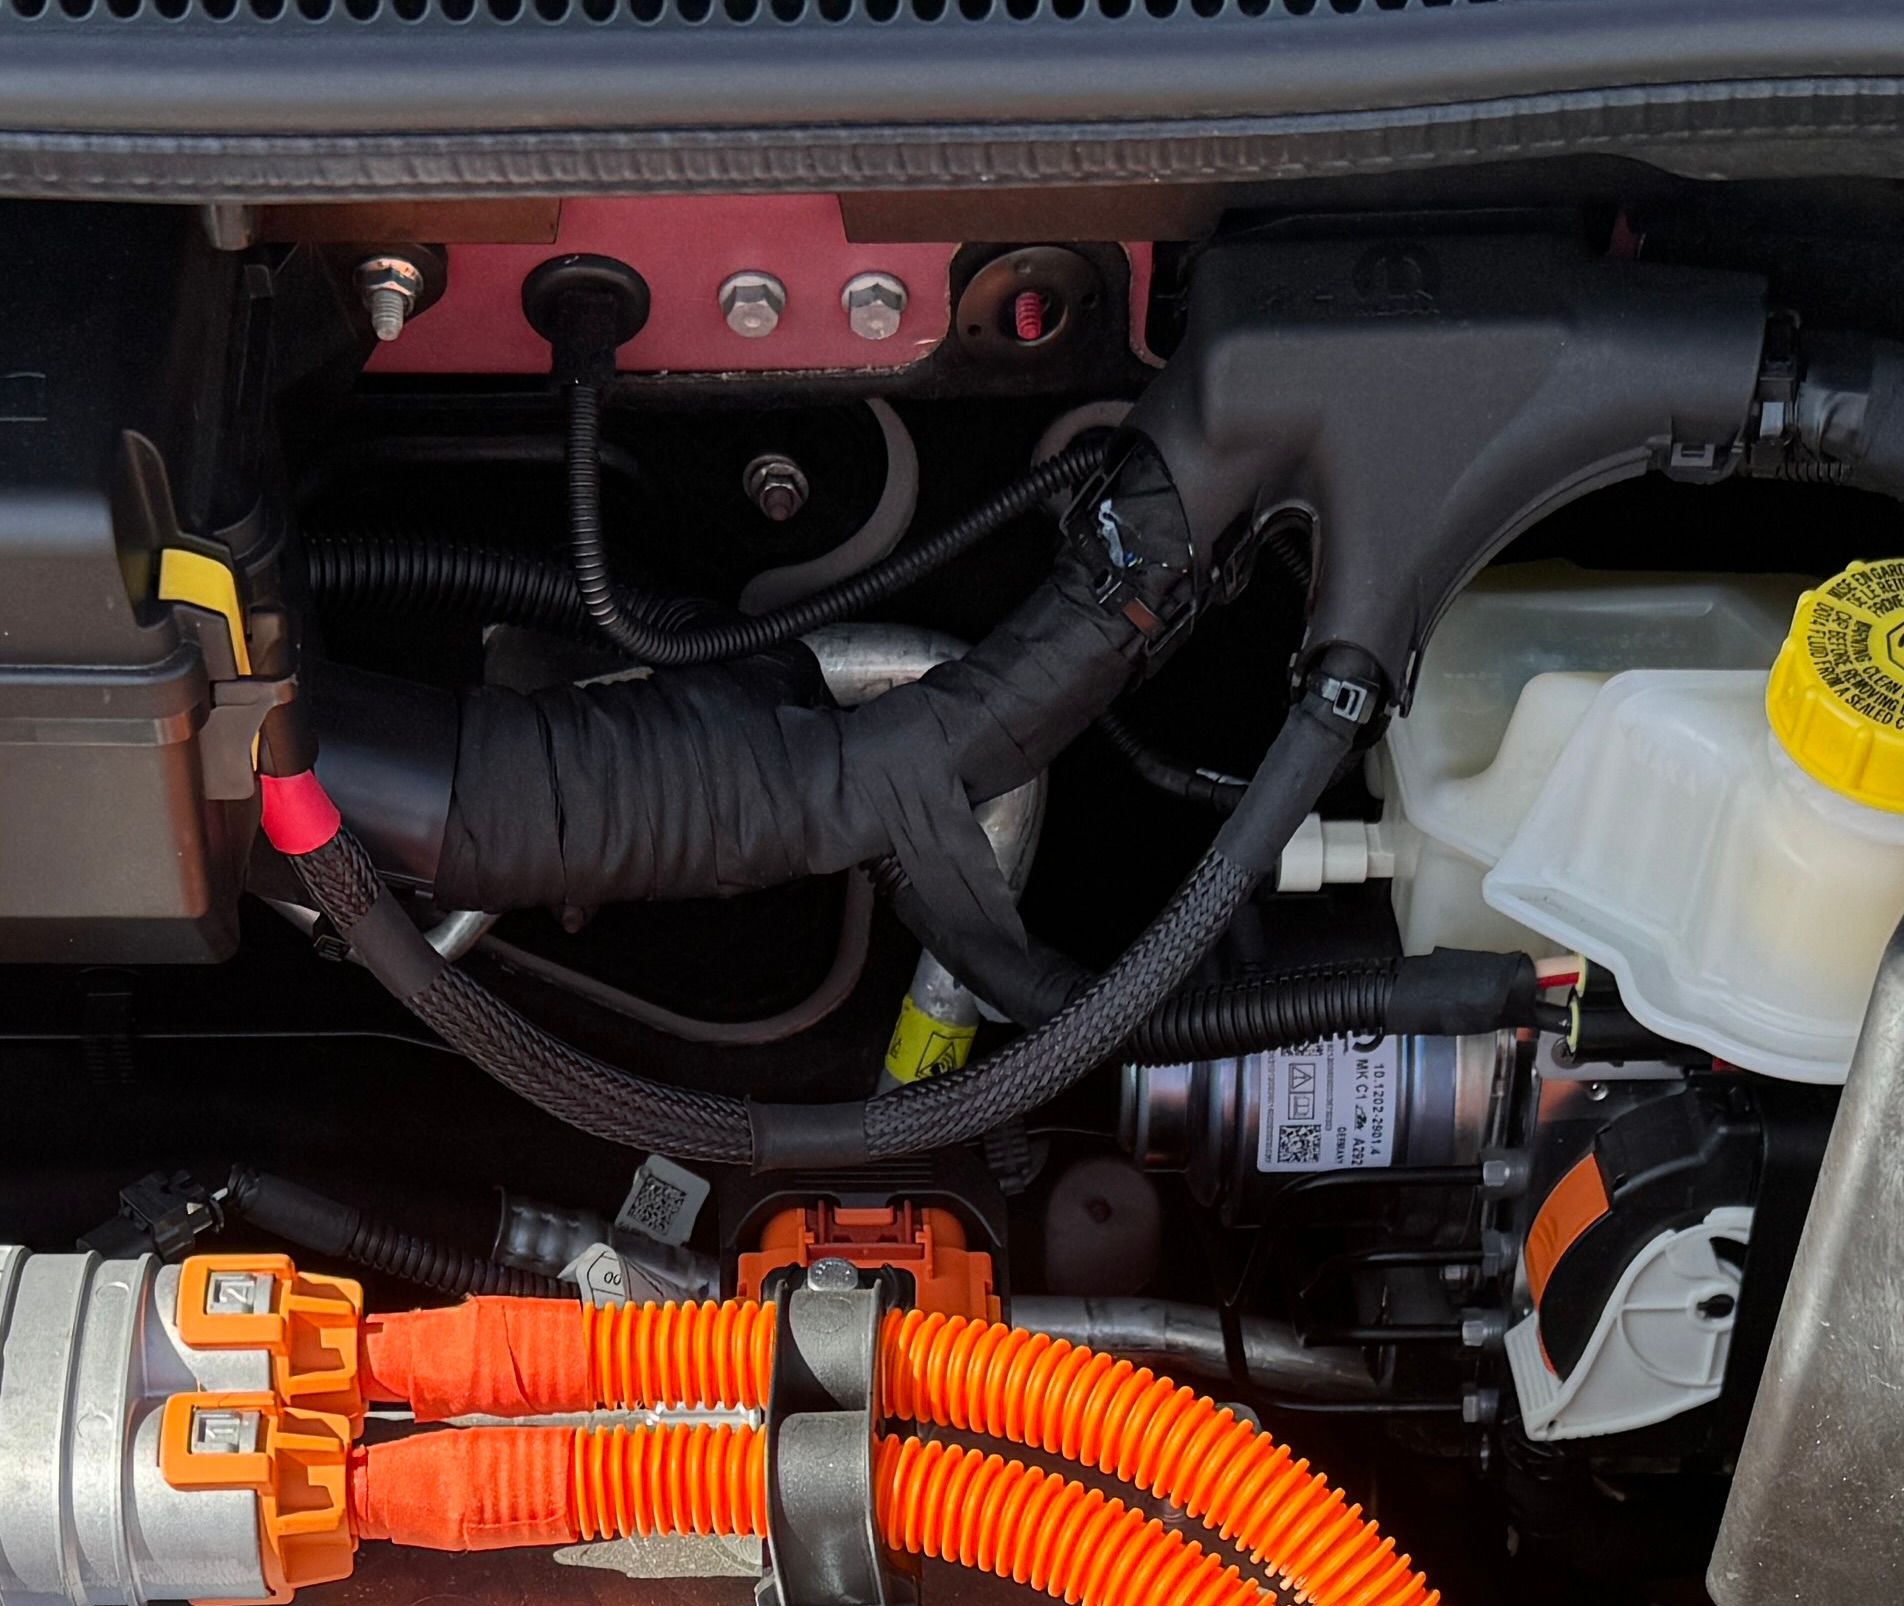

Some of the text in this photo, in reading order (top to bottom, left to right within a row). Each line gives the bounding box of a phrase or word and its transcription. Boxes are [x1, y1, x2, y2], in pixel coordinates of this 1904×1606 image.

[1809, 629, 1831, 658] FLUID
[1830, 629, 1855, 667] BEFORE
[1816, 660, 1848, 689] FROM
[1842, 667, 1901, 713] REMOVING
[1863, 664, 1904, 696] CLEAN
[1846, 692, 1895, 726] SEALED
[1356, 1059, 1369, 1080] MK
[1356, 1084, 1368, 1100] C1
[1336, 1126, 1347, 1164] GERMANY
